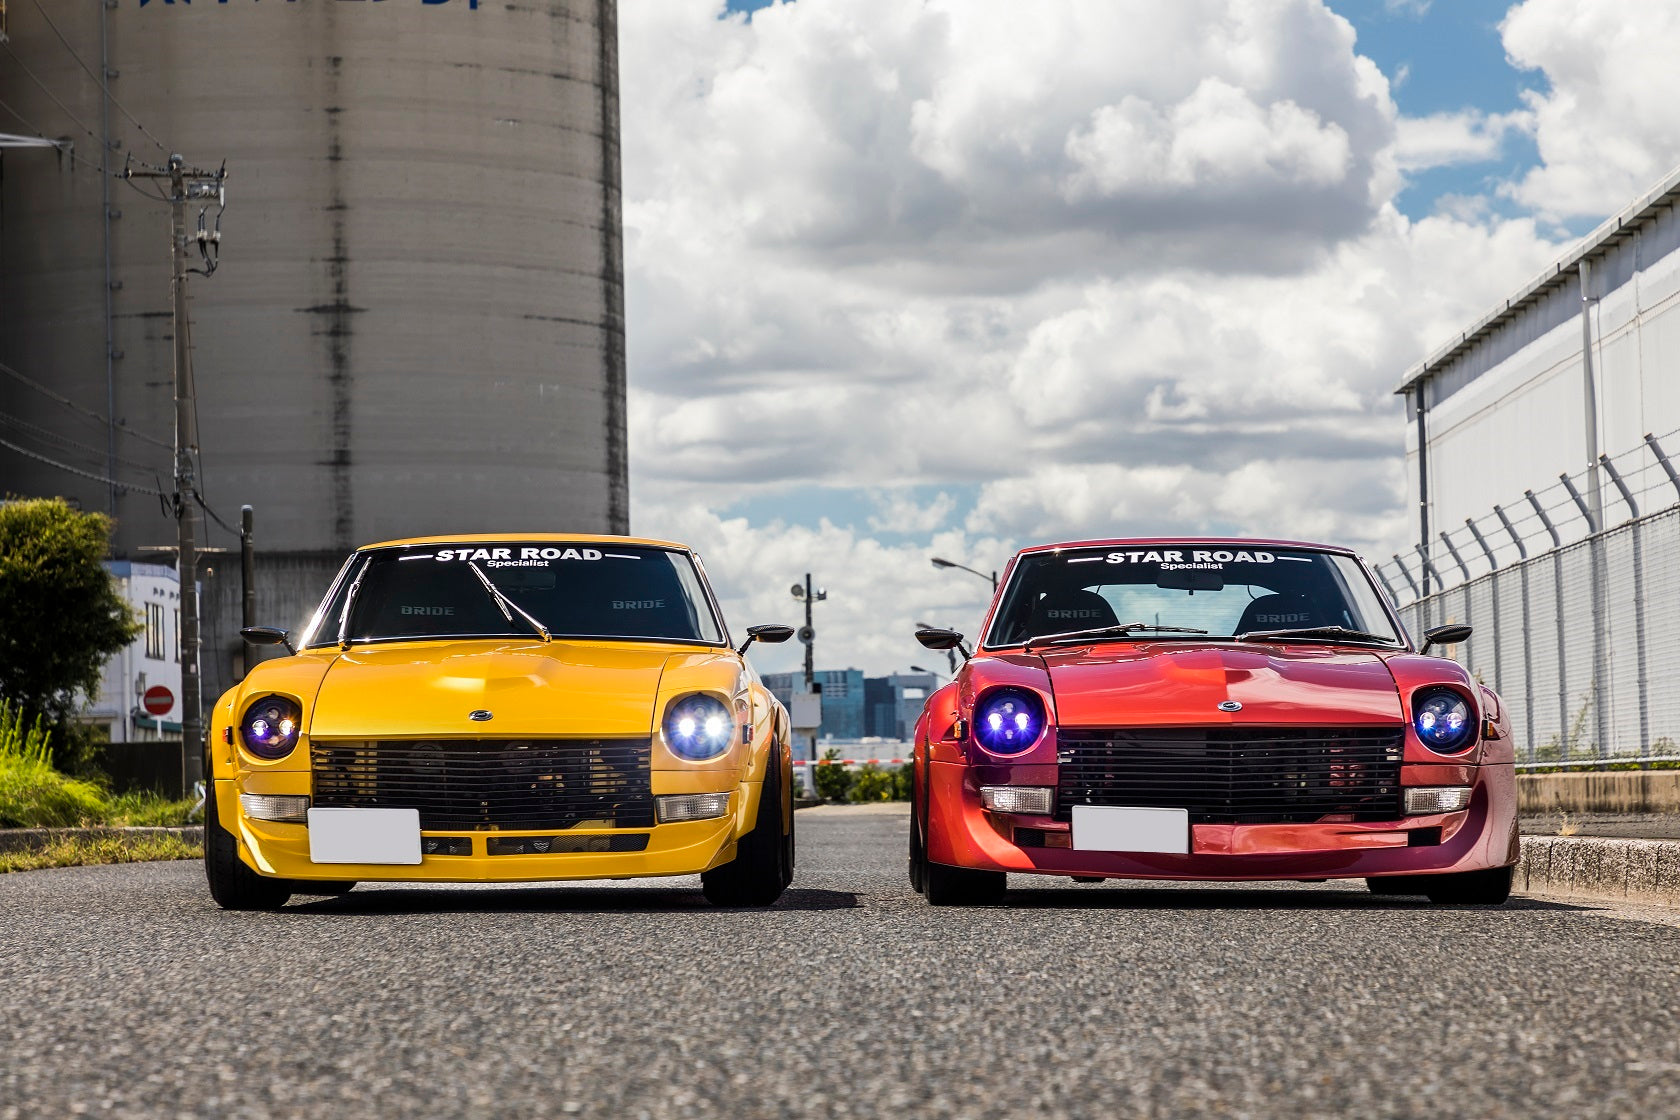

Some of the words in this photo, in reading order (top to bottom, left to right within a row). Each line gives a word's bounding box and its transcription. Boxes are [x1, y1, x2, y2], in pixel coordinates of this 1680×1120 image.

[435, 548, 512, 562] STAR
[521, 547, 602, 561] ROAD
[1106, 550, 1184, 564] STAR
[1193, 550, 1275, 563] ROAD
[487, 560, 549, 568] Specialist
[1160, 562, 1223, 570] Specialist
[612, 600, 665, 610] BRIDE
[401, 605, 455, 616] BRIDE
[1048, 609, 1101, 619] BRIDE
[1255, 612, 1309, 623] BRIDE
